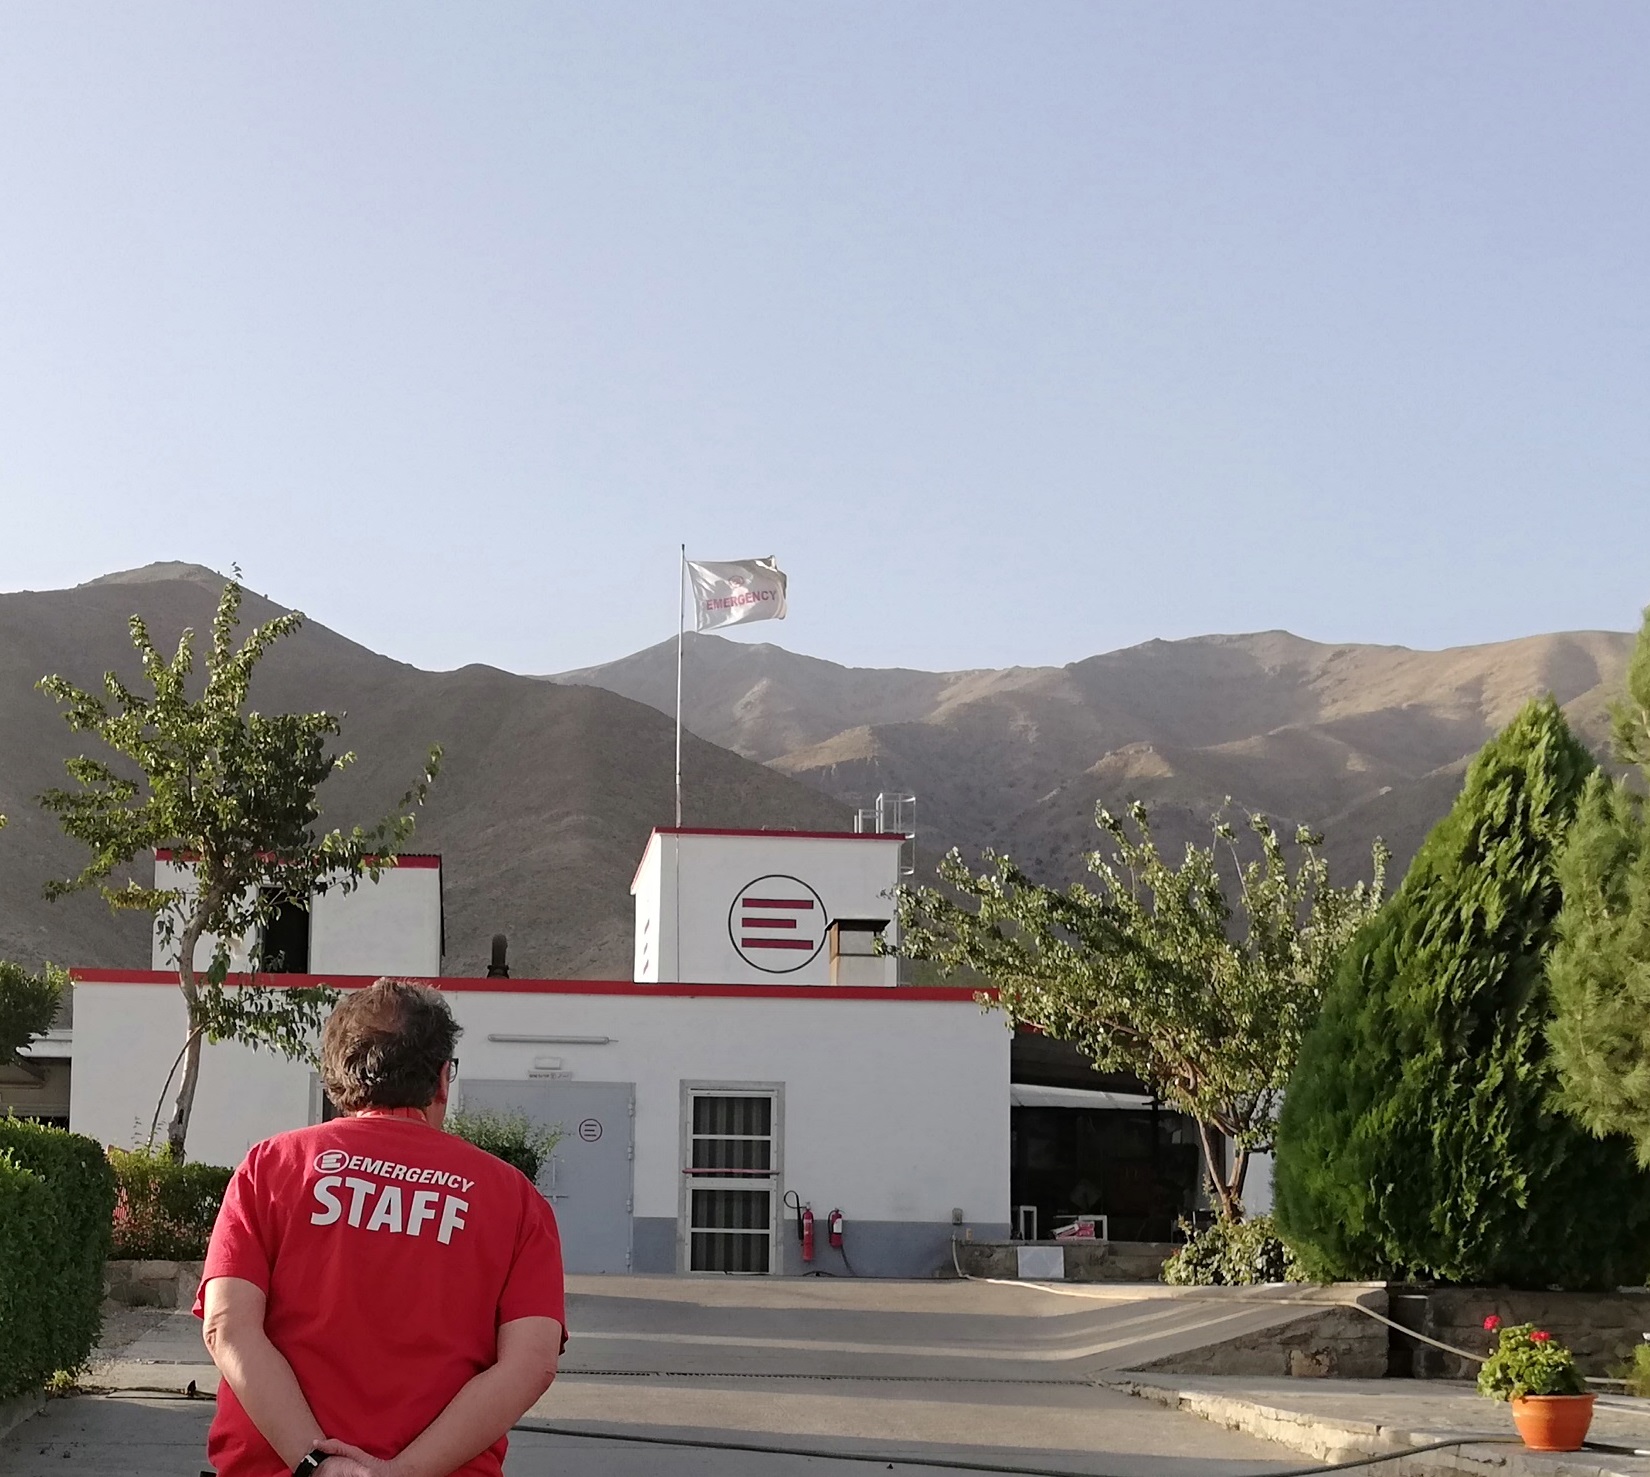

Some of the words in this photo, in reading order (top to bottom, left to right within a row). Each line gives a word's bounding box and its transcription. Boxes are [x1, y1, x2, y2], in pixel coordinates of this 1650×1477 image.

[706, 590, 777, 610] EMERGENCY
[348, 1156, 475, 1193] EMERGENCY
[310, 1175, 470, 1246] STAFF
